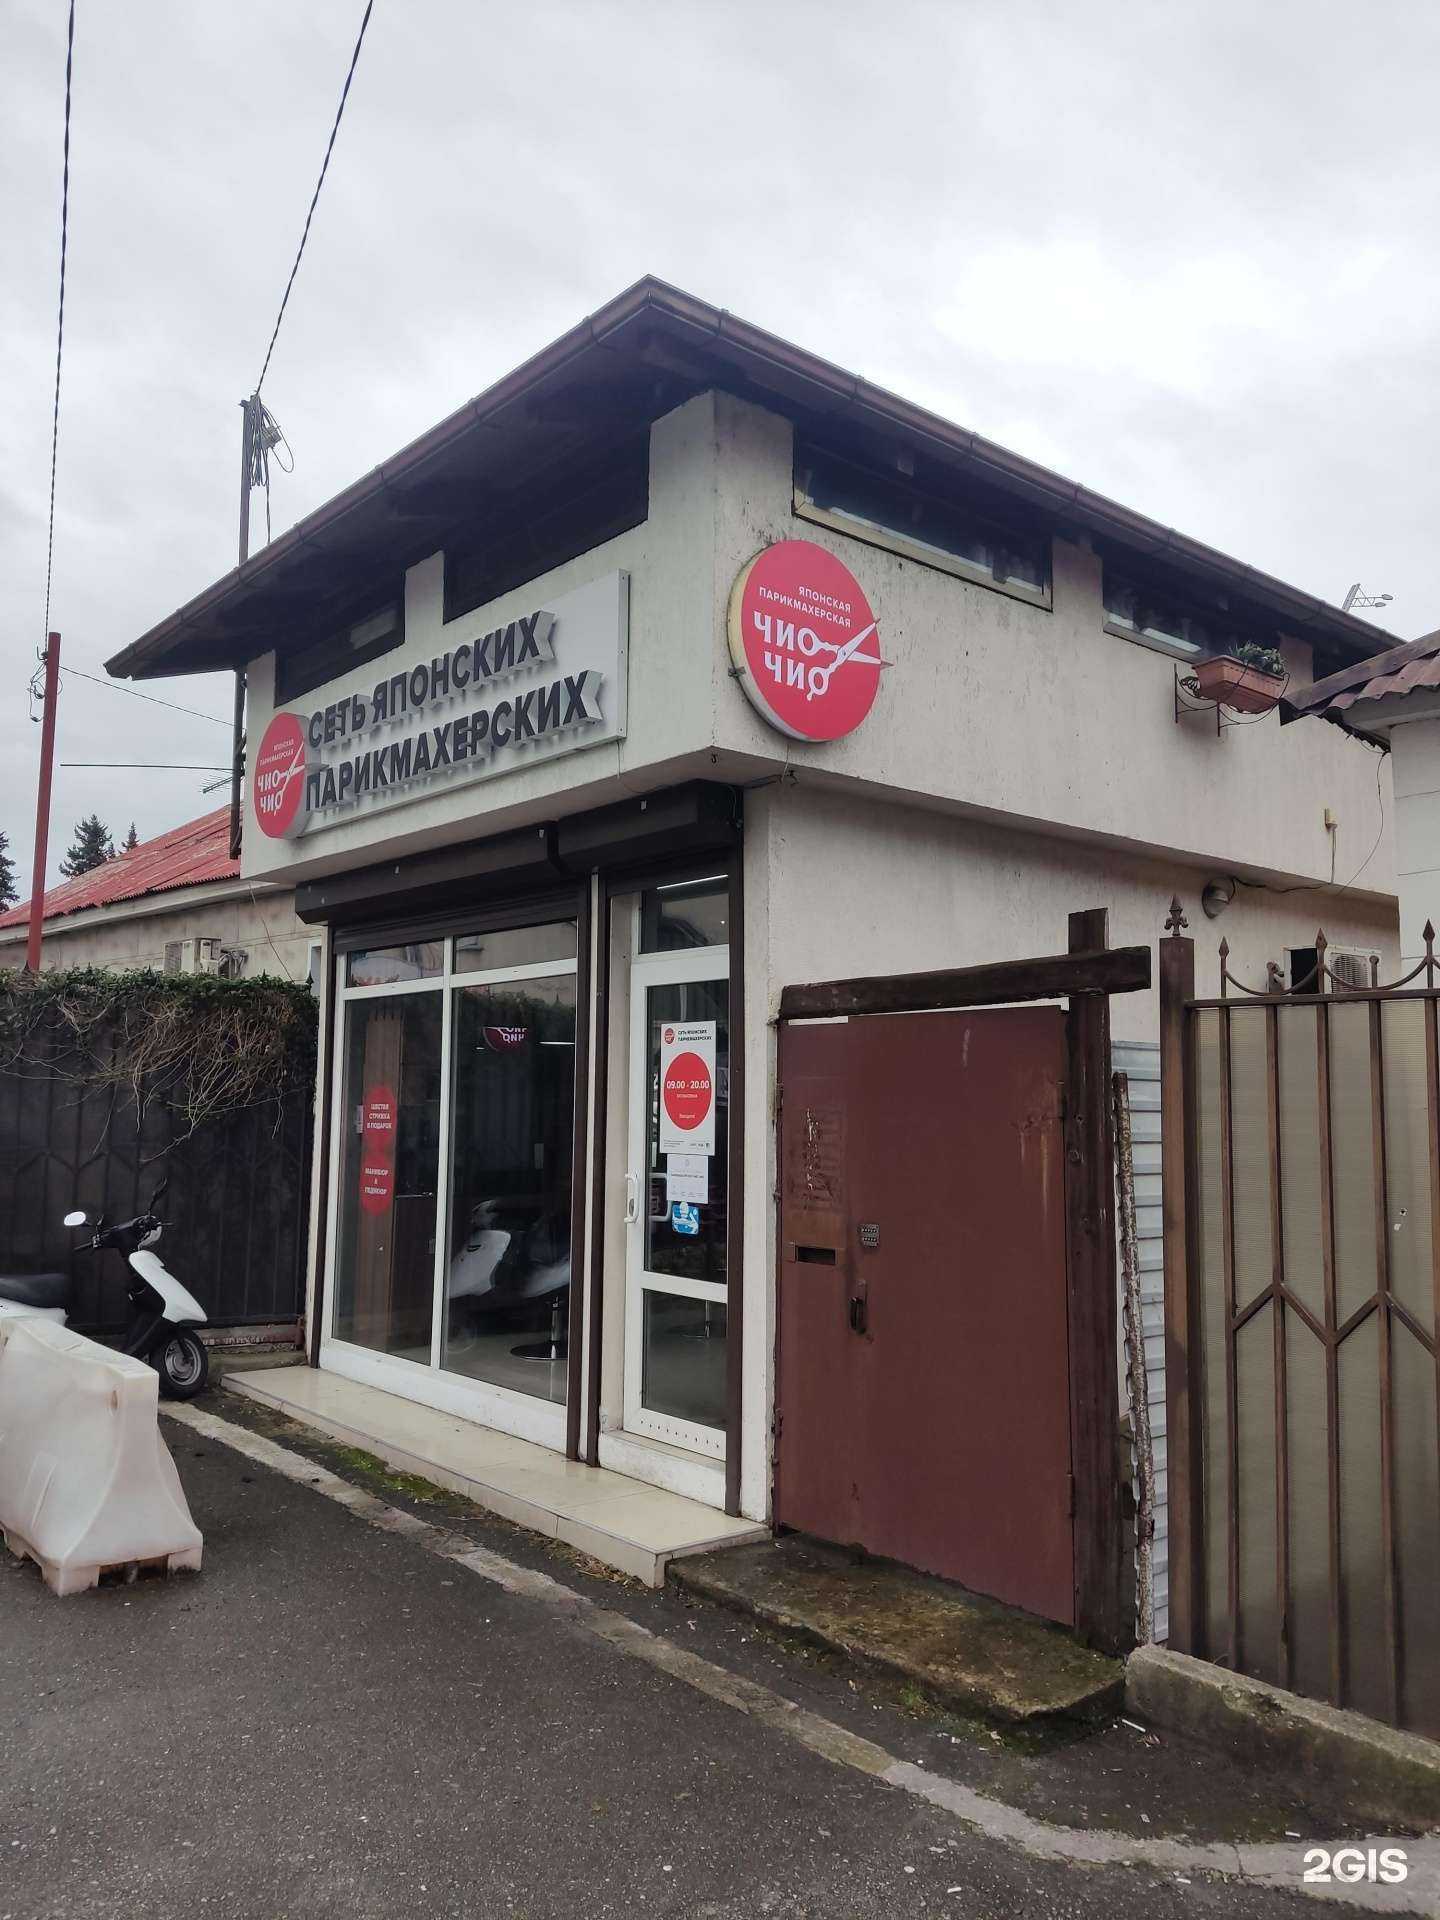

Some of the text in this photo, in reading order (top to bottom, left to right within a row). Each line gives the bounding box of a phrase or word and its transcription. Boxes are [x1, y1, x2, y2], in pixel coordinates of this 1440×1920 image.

[759, 586, 852, 628] ПАРИКМАХЕРСКАЯ
[798, 586, 852, 613] ЯПОНСКАЯ
[753, 610, 817, 657] ЧИО
[307, 610, 546, 749] СЕТЬ ЯПОНСКИХ
[763, 650, 829, 701] ЧИО
[305, 669, 592, 812] ПАРИКМАХЕРСКИХ
[257, 769, 281, 793] ЧИО
[260, 790, 284, 815] ЧИО
[666, 1080, 686, 1089] 09.00
[690, 1080, 710, 1089] 20.00
